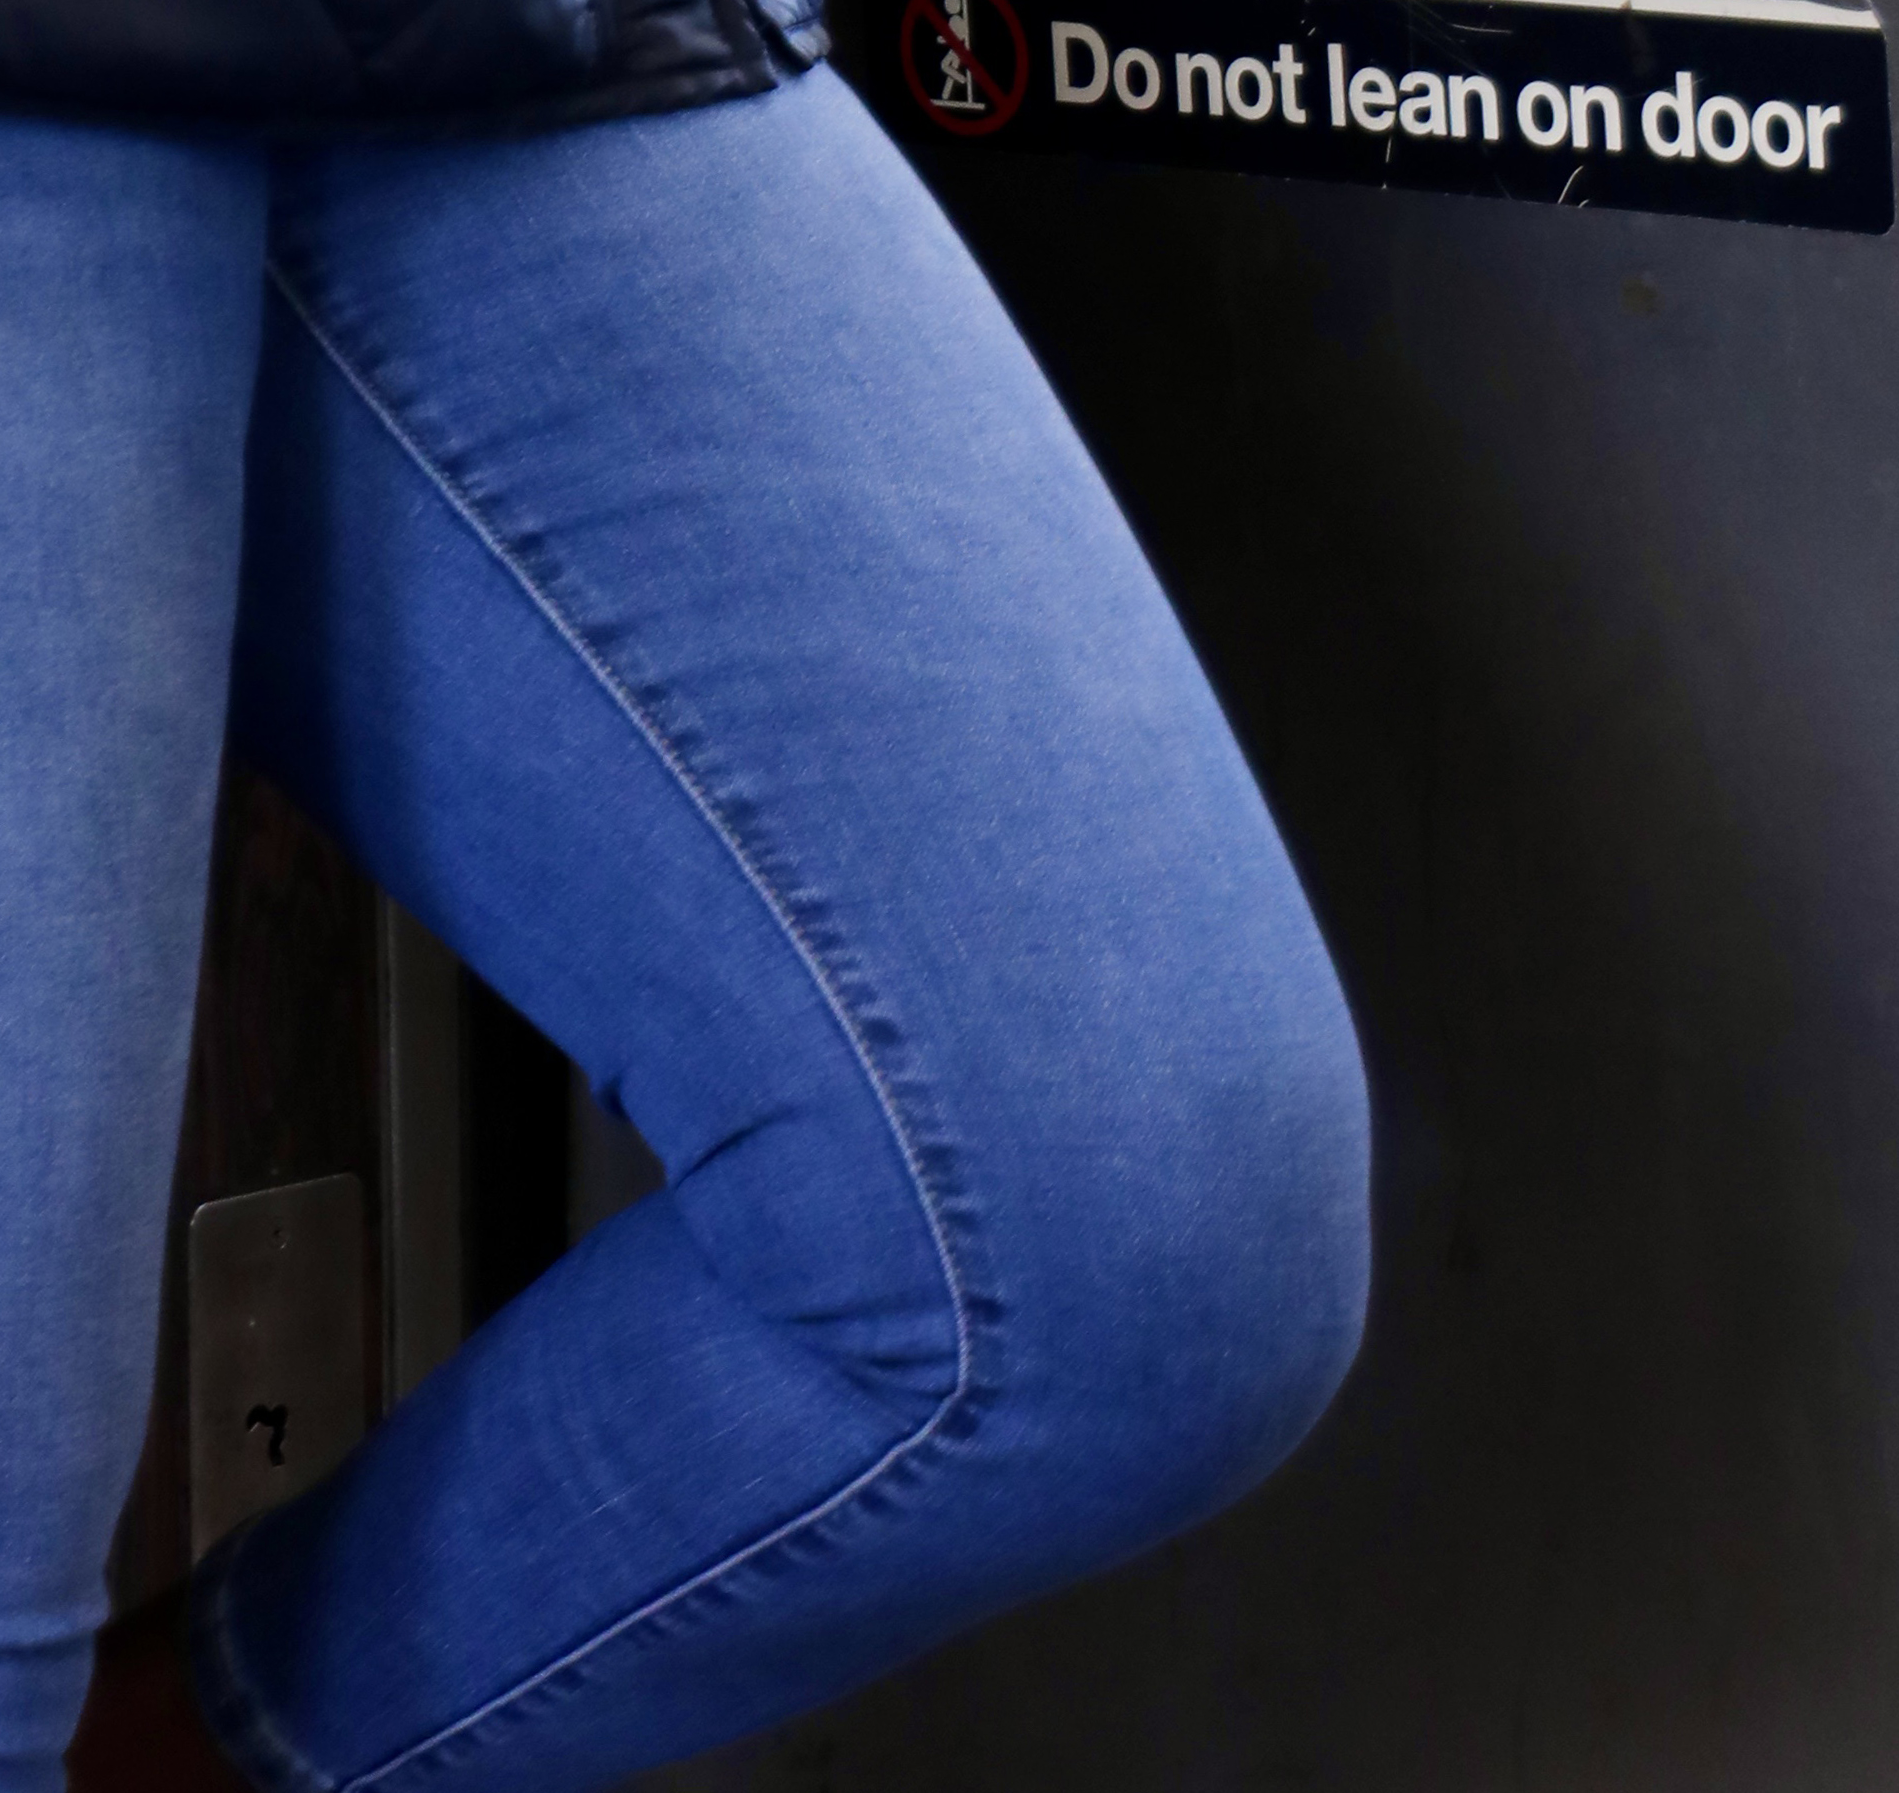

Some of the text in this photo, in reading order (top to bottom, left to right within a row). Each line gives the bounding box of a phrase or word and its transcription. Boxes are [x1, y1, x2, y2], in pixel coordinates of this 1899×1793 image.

[1051, 20, 1841, 170] Do not lean on door
